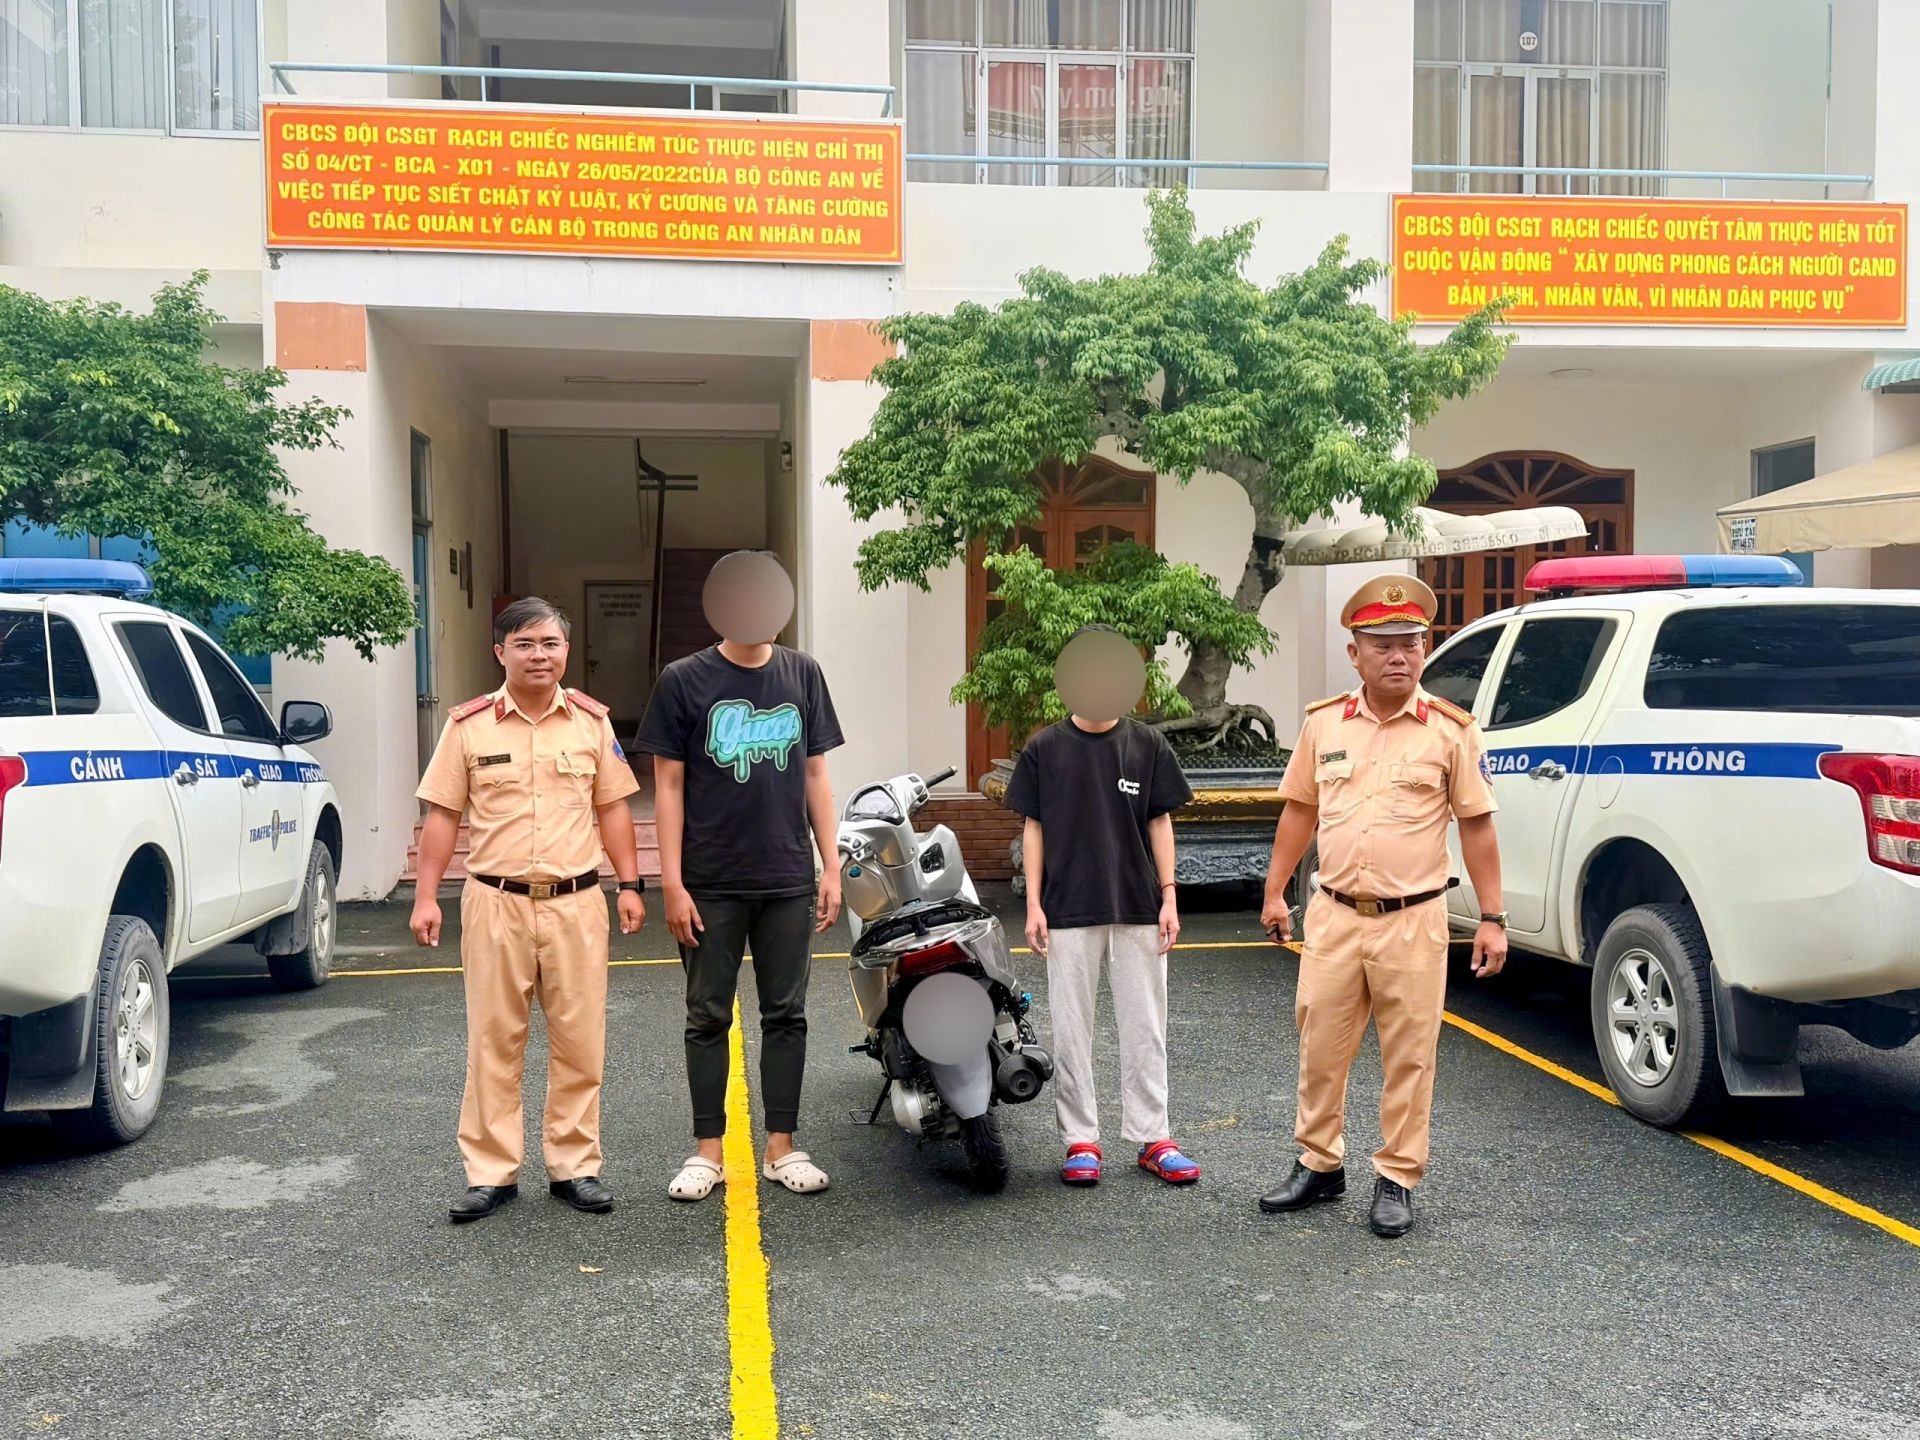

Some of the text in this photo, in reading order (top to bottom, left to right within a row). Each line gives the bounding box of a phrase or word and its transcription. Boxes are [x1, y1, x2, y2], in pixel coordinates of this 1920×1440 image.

[1521, 36, 1537, 46] 107
[281, 123, 337, 142] CBCS
[344, 122, 379, 145] ĐỘI
[385, 127, 437, 146] CSGT
[447, 128, 503, 149] RẠCH
[509, 127, 569, 150] CHIẾC
[575, 132, 656, 153] NGHIÊM
[662, 133, 699, 154] TÚC
[706, 138, 756, 159] THỰC
[763, 138, 809, 161] HIỆN
[853, 143, 884, 165] THỊ
[282, 147, 310, 170] SỐ
[315, 154, 373, 172] 04/CT
[394, 156, 437, 174] BCA
[457, 158, 493, 176] X01
[516, 157, 571, 179] NGÀY
[735, 165, 761, 189] BỘ
[768, 166, 821, 187] CÔNG
[828, 171, 855, 189] AN
[278, 178, 889, 218] VIỆC TIẾP TỤC SIẾT CHẶT KỶ LUẬT, KỶ CƯƠNG VÀ TĂNG CƯỜNG
[308, 209, 861, 246] CÔNG TÁC QUẢN LÝ CÁN BỘ TRONG CÔNG AN NHÂN DÂN
[1403, 212, 1896, 246] CBCS ĐỘI CSGT RẠCH CHIẾC QUYẾT TÂM THỰC HIỆN TỐT
[1403, 246, 1453, 275] CUỘC
[1458, 247, 1497, 275] VẬN
[1501, 247, 1552, 276] ĐỘNG
[1573, 249, 1610, 272] XÂY
[1615, 252, 1664, 277] DỰNG
[1669, 253, 1731, 275] PHONG
[1736, 251, 1784, 275] CÁCH
[1789, 251, 1844, 277] NGƯỜI
[1848, 256, 1897, 277] CAND
[1447, 278, 1487, 306] BẢN
[1544, 282, 1597, 307] NHÂN
[1601, 282, 1643, 308] VĂN,
[1649, 283, 1666, 308] VÌ
[1671, 284, 1722, 308] NHÂN
[1727, 284, 1765, 309] DÂN
[1769, 289, 1817, 314] PHỤC
[70, 751, 125, 781] CẢNH
[194, 755, 219, 777] SÁT
[259, 763, 282, 781] GIAO
[1488, 746, 1746, 772] GIAO THÔNG
[249, 819, 297, 843] TRAFFIC POLICE
